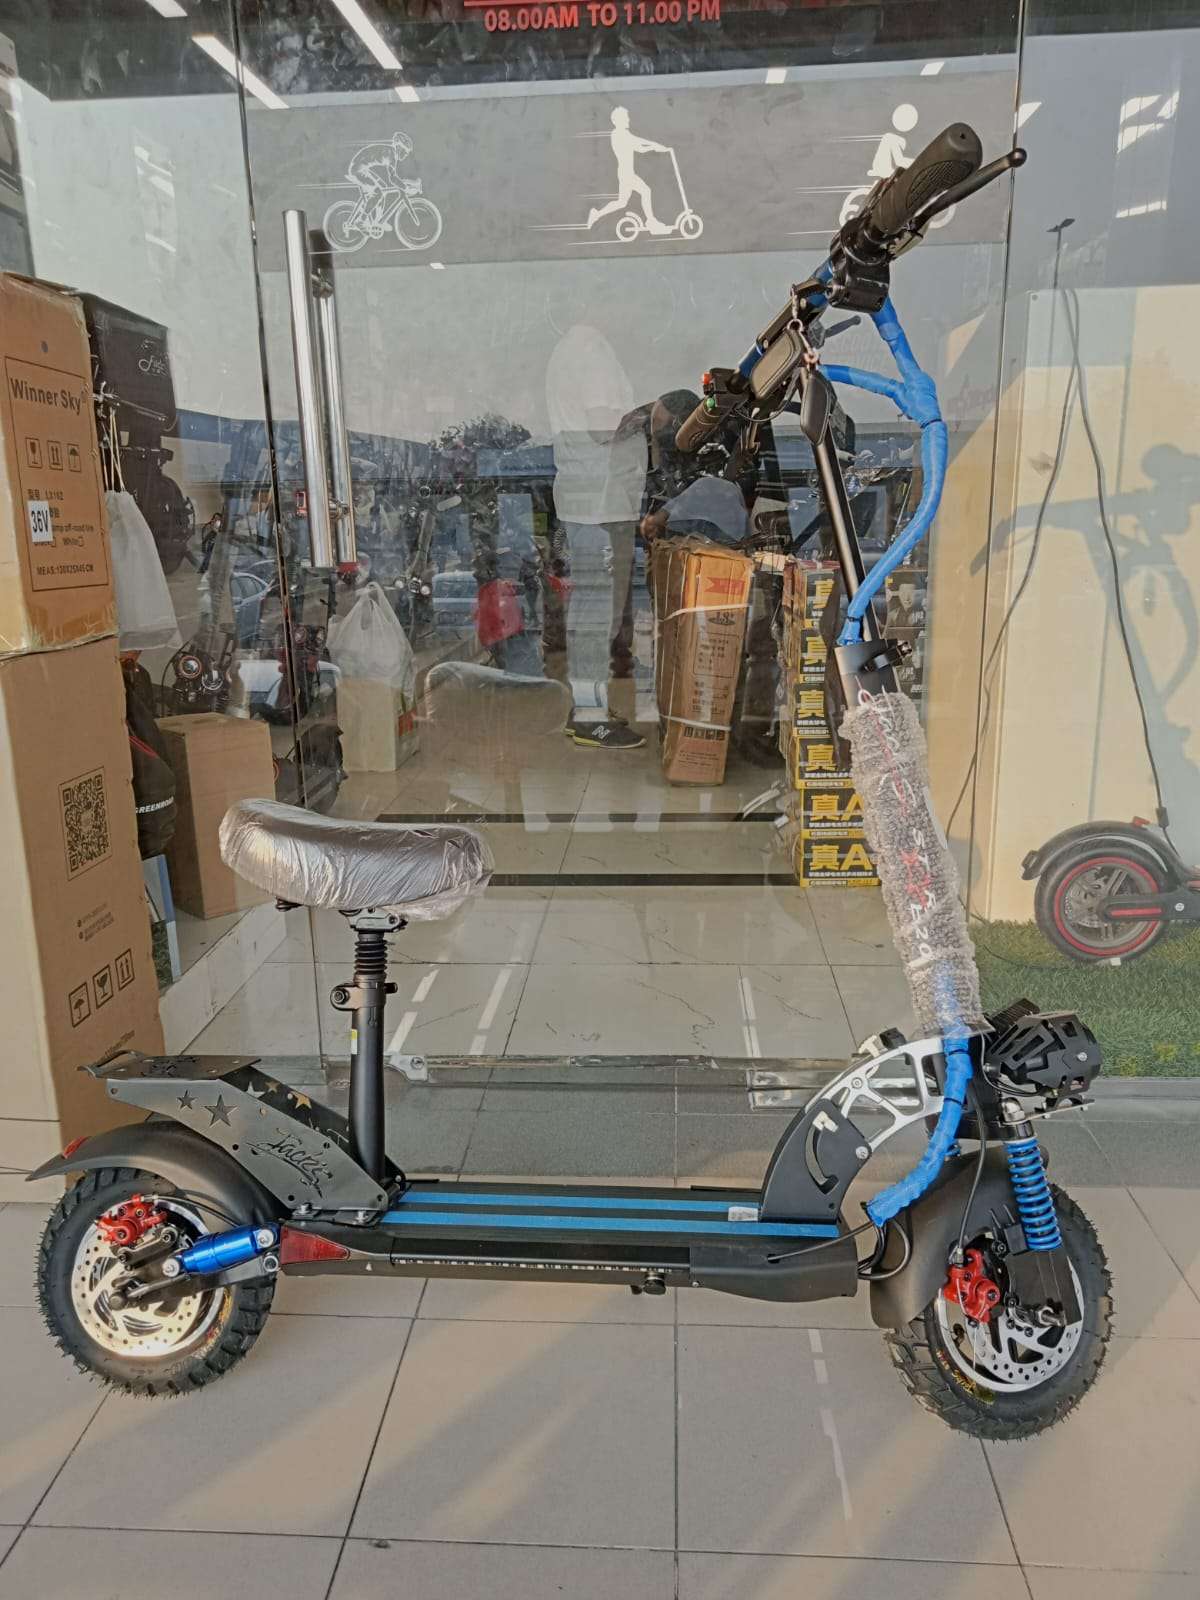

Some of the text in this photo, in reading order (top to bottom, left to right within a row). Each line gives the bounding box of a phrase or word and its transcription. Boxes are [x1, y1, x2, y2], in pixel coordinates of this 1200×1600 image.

[484, 0, 721, 32] 08.00AM TO 11.00 PM
[10, 378, 80, 415] Winner Sky
[31, 510, 49, 533] 36V
